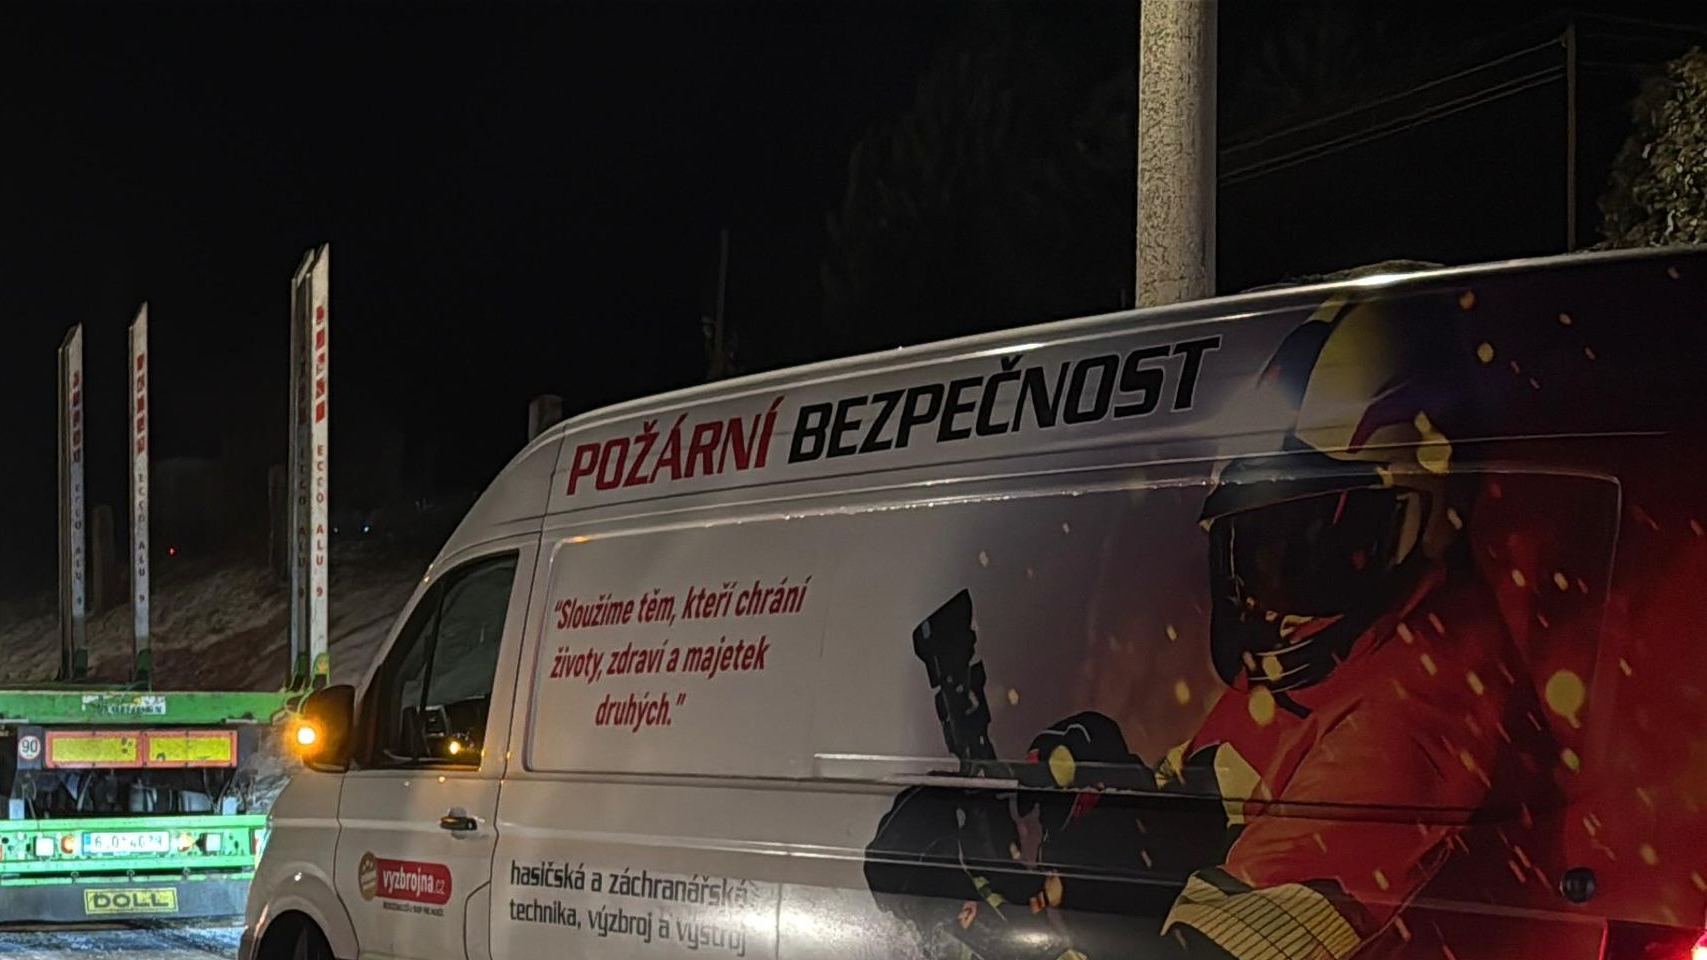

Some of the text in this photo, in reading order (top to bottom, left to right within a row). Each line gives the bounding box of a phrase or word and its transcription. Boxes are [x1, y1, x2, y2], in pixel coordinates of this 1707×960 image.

[566, 335, 1222, 496] POŽÁRNÍ BEZPEČNOST
[315, 445, 325, 597] ECCO ALU 9
[138, 541, 146, 577] ALU
[637, 588, 676, 627] těm,
[681, 581, 738, 620] kteří
[735, 575, 812, 617] chrání
[549, 635, 770, 684] životy, zdraví a majetek
[22, 739, 38, 753] 90
[92, 892, 169, 908] DOLL
[383, 864, 446, 898] vyzbrojna.cz
[510, 859, 747, 909] hasičská a záchranářská
[510, 898, 582, 930] technika,
[588, 905, 653, 943] výzbroj
[658, 915, 670, 939] a
